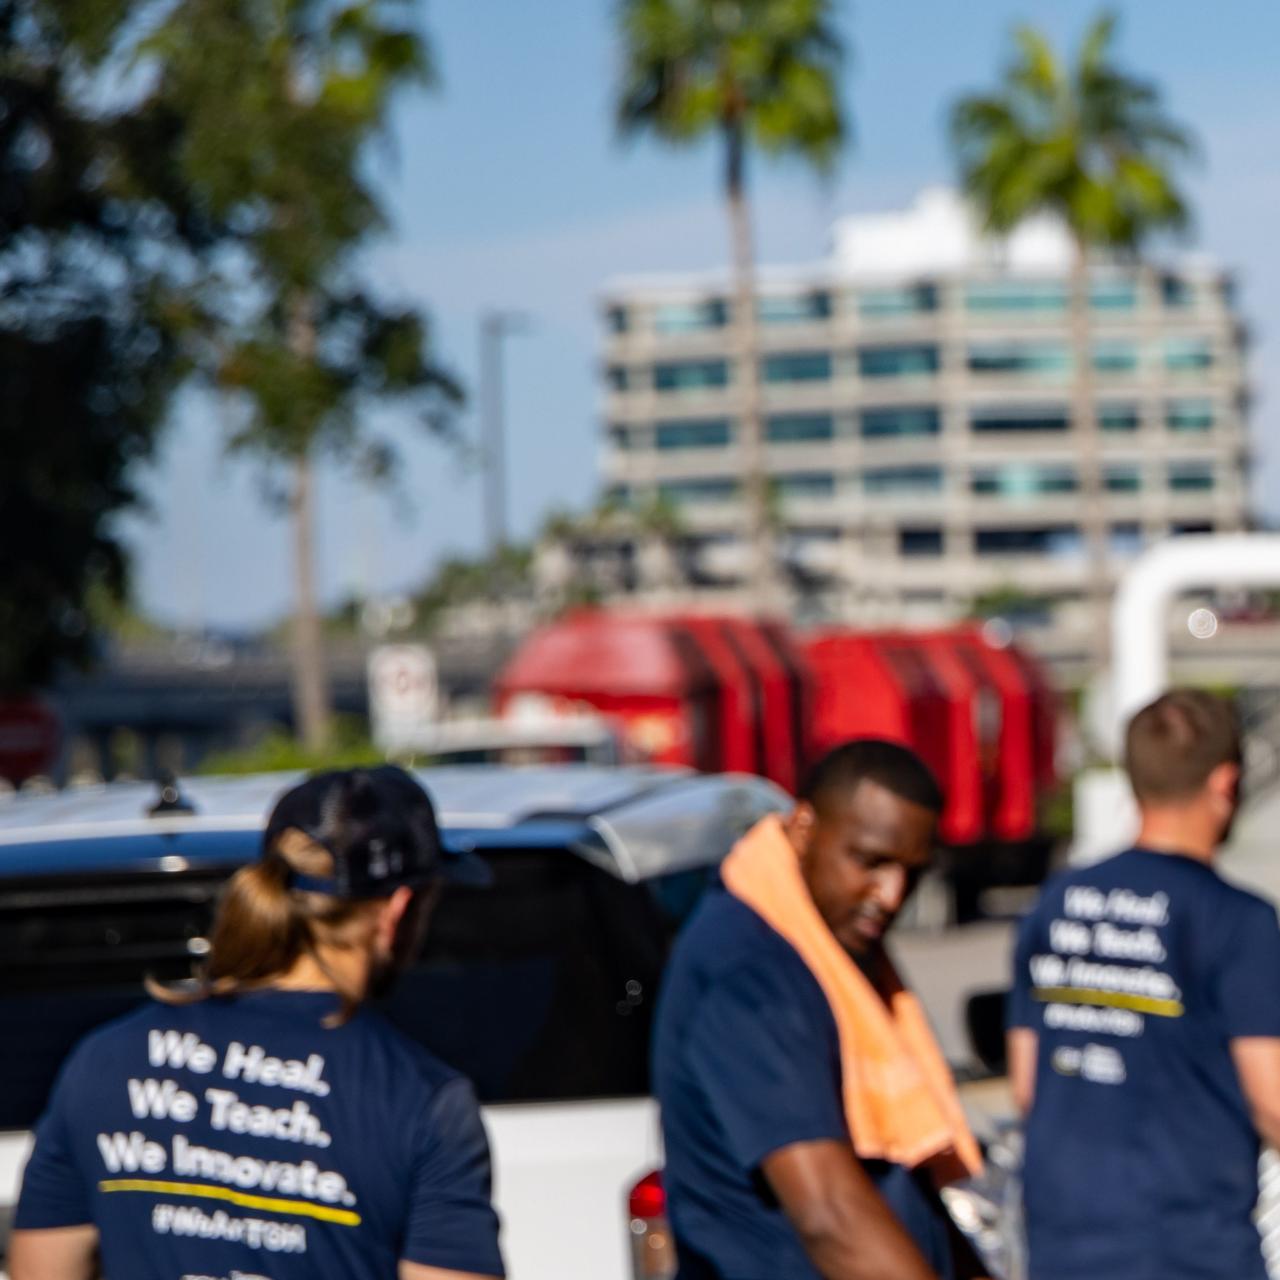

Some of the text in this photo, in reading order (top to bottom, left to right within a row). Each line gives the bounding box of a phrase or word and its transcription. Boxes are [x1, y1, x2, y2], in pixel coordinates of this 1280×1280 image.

[148, 1029, 331, 1097] We Heal.
[127, 1078, 332, 1148] We Teach.
[96, 1131, 357, 1207] We Innovate.
